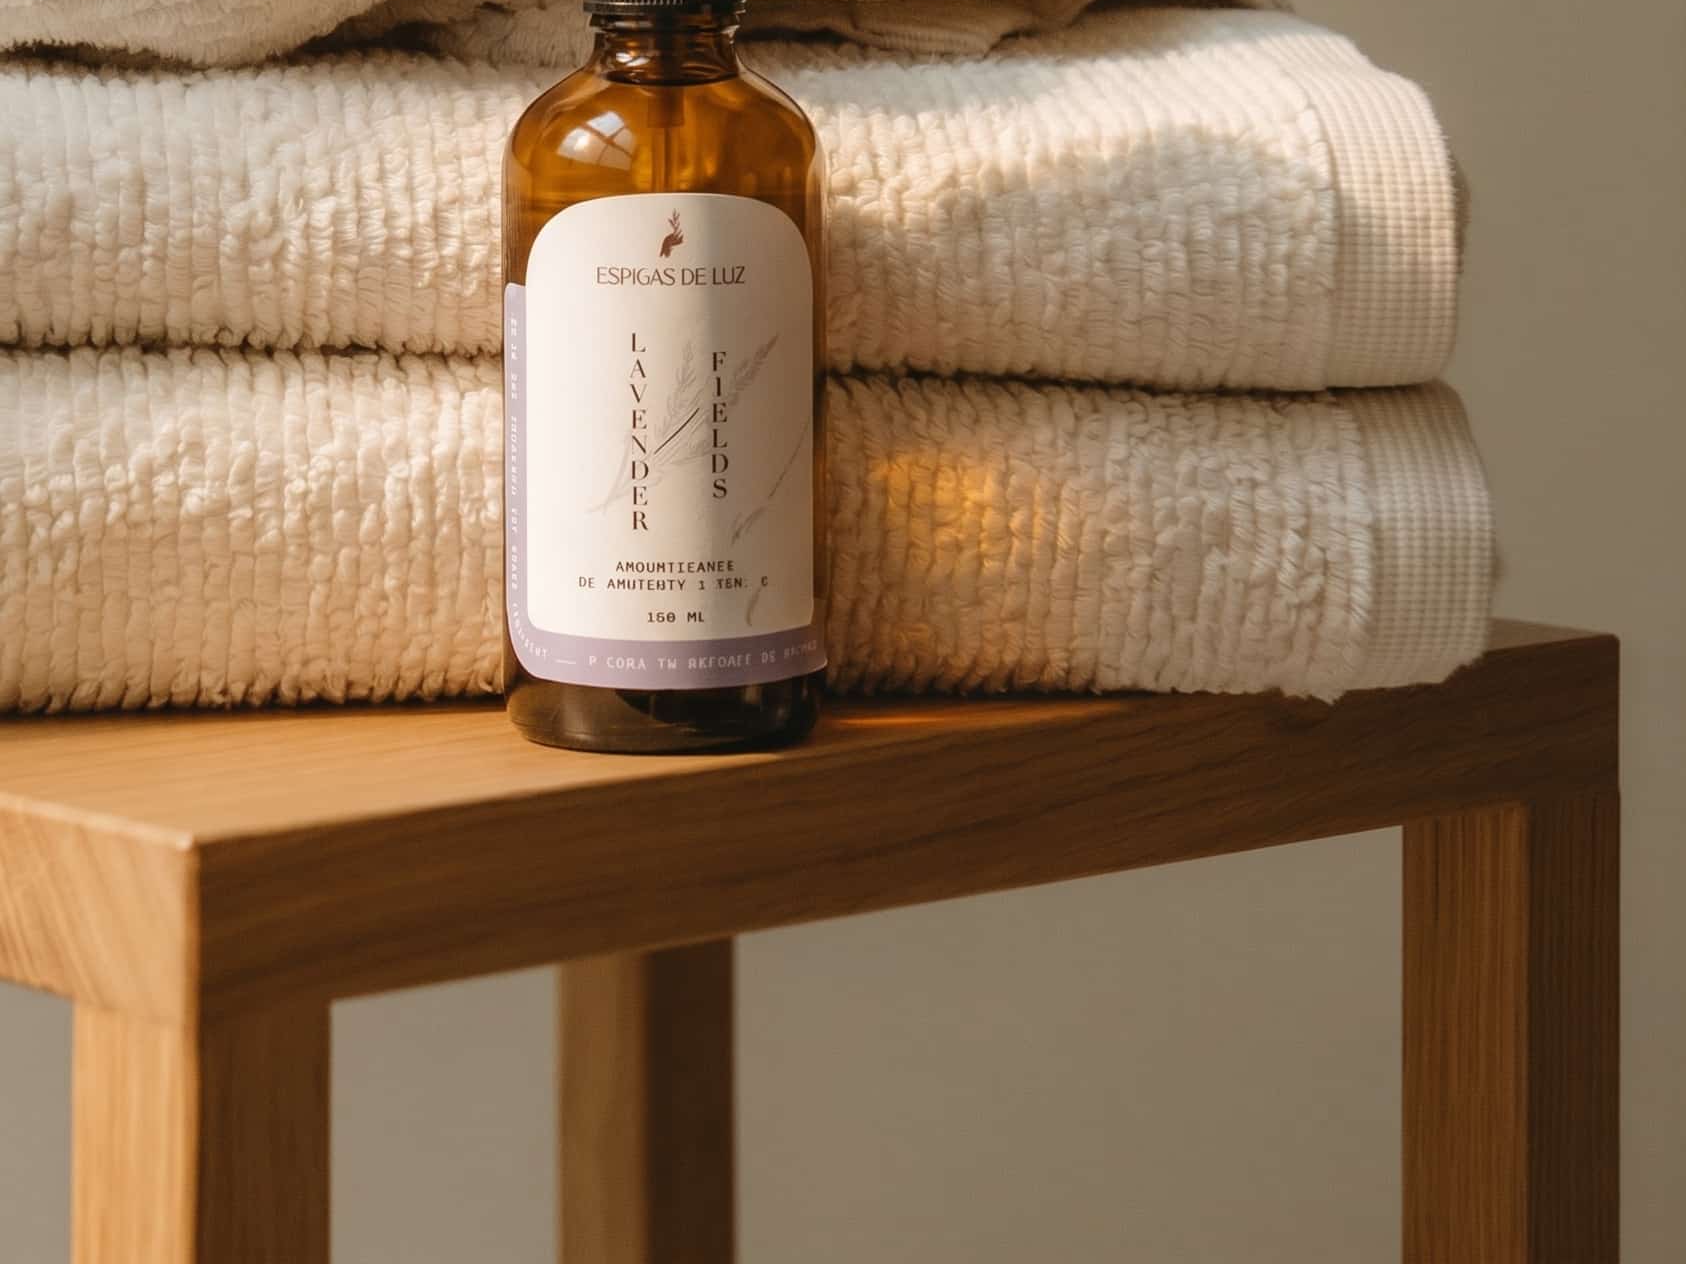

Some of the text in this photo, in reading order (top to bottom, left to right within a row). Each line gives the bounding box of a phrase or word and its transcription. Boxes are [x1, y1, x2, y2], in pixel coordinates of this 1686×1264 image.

[596, 266, 746, 286] ESPIGAS DE LUZ
[630, 332, 649, 531] LAVENDER
[711, 351, 729, 500] FIELDS
[578, 576, 596, 589] DE
[687, 611, 705, 624] ML
